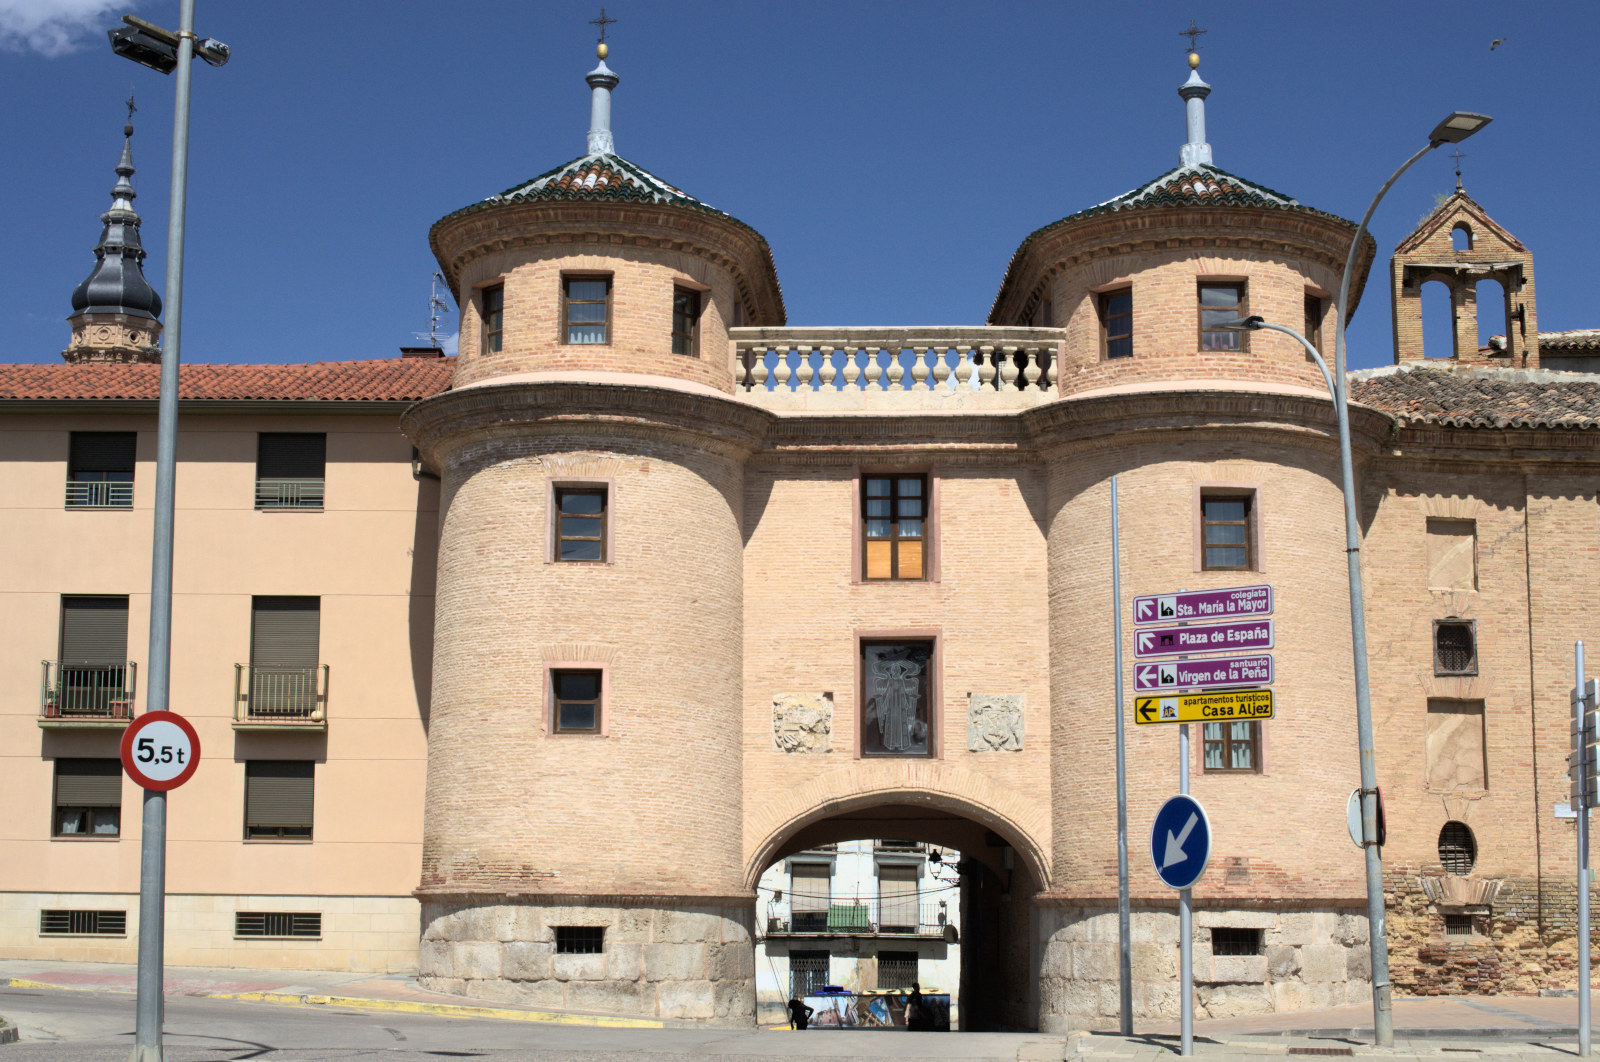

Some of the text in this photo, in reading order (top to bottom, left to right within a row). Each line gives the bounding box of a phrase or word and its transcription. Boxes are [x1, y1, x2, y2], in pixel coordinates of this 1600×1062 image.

[1231, 590, 1266, 600] colegiata
[1177, 599, 1266, 616] Sta. María la Mayor
[1180, 627, 1268, 644] Plaza de España
[1230, 659, 1268, 668] santuario
[1179, 667, 1267, 684] Virgen de la Peña
[1184, 696, 1233, 706] apartamentos
[1202, 703, 1269, 716] Casa Aljez
[137, 738, 184, 764] 5,5 t
